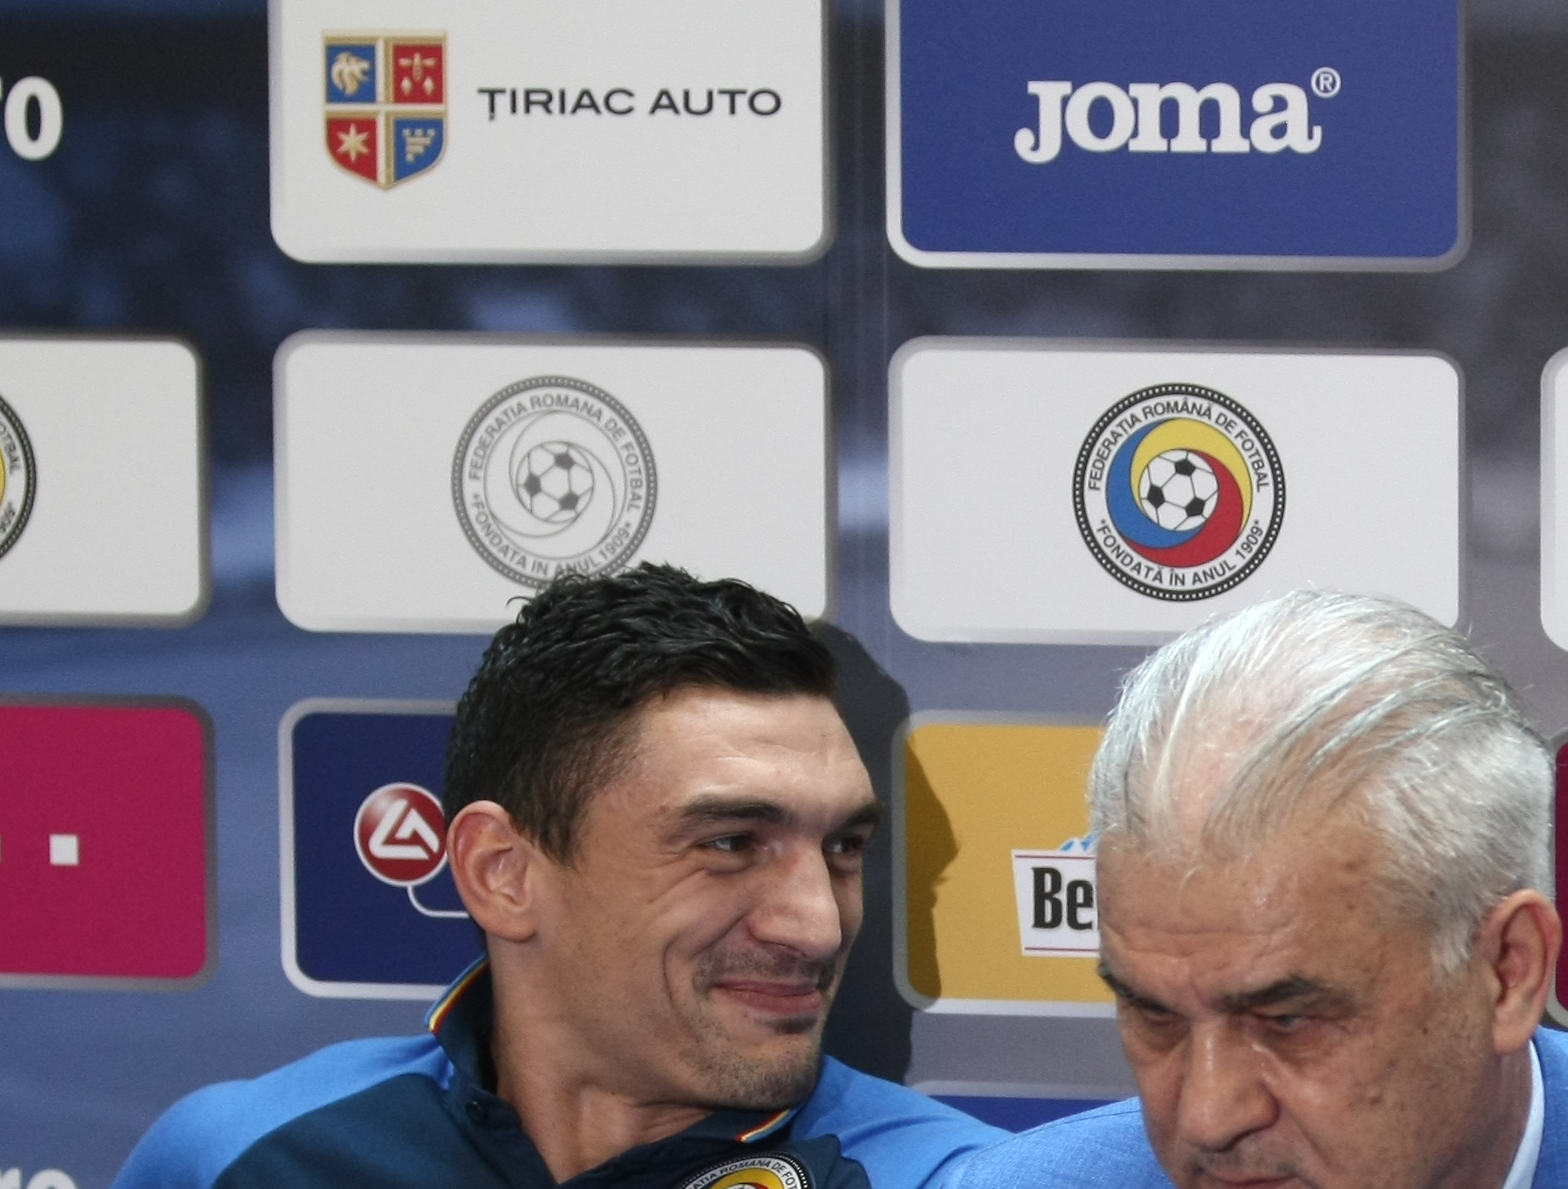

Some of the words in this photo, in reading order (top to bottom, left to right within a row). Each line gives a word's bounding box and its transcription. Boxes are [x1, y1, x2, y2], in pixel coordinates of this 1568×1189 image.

[649, 88, 782, 116] AUTO
[469, 401, 528, 481] FEDERATIA
[530, 394, 603, 422] ROMANA
[604, 418, 626, 441] DE
[621, 442, 643, 512] FOTBAL
[1214, 412, 1237, 433] DE
[1235, 429, 1269, 492] FOTBAL
[471, 500, 528, 569] FONDATA
[531, 560, 548, 575] IN
[600, 527, 630, 560] 1909
[1169, 569, 1185, 586] ÎN
[1192, 560, 1236, 586] ANUL
[1235, 528, 1263, 560] 1909
[1032, 867, 1099, 930] Be
[771, 1162, 785, 1173] DE
